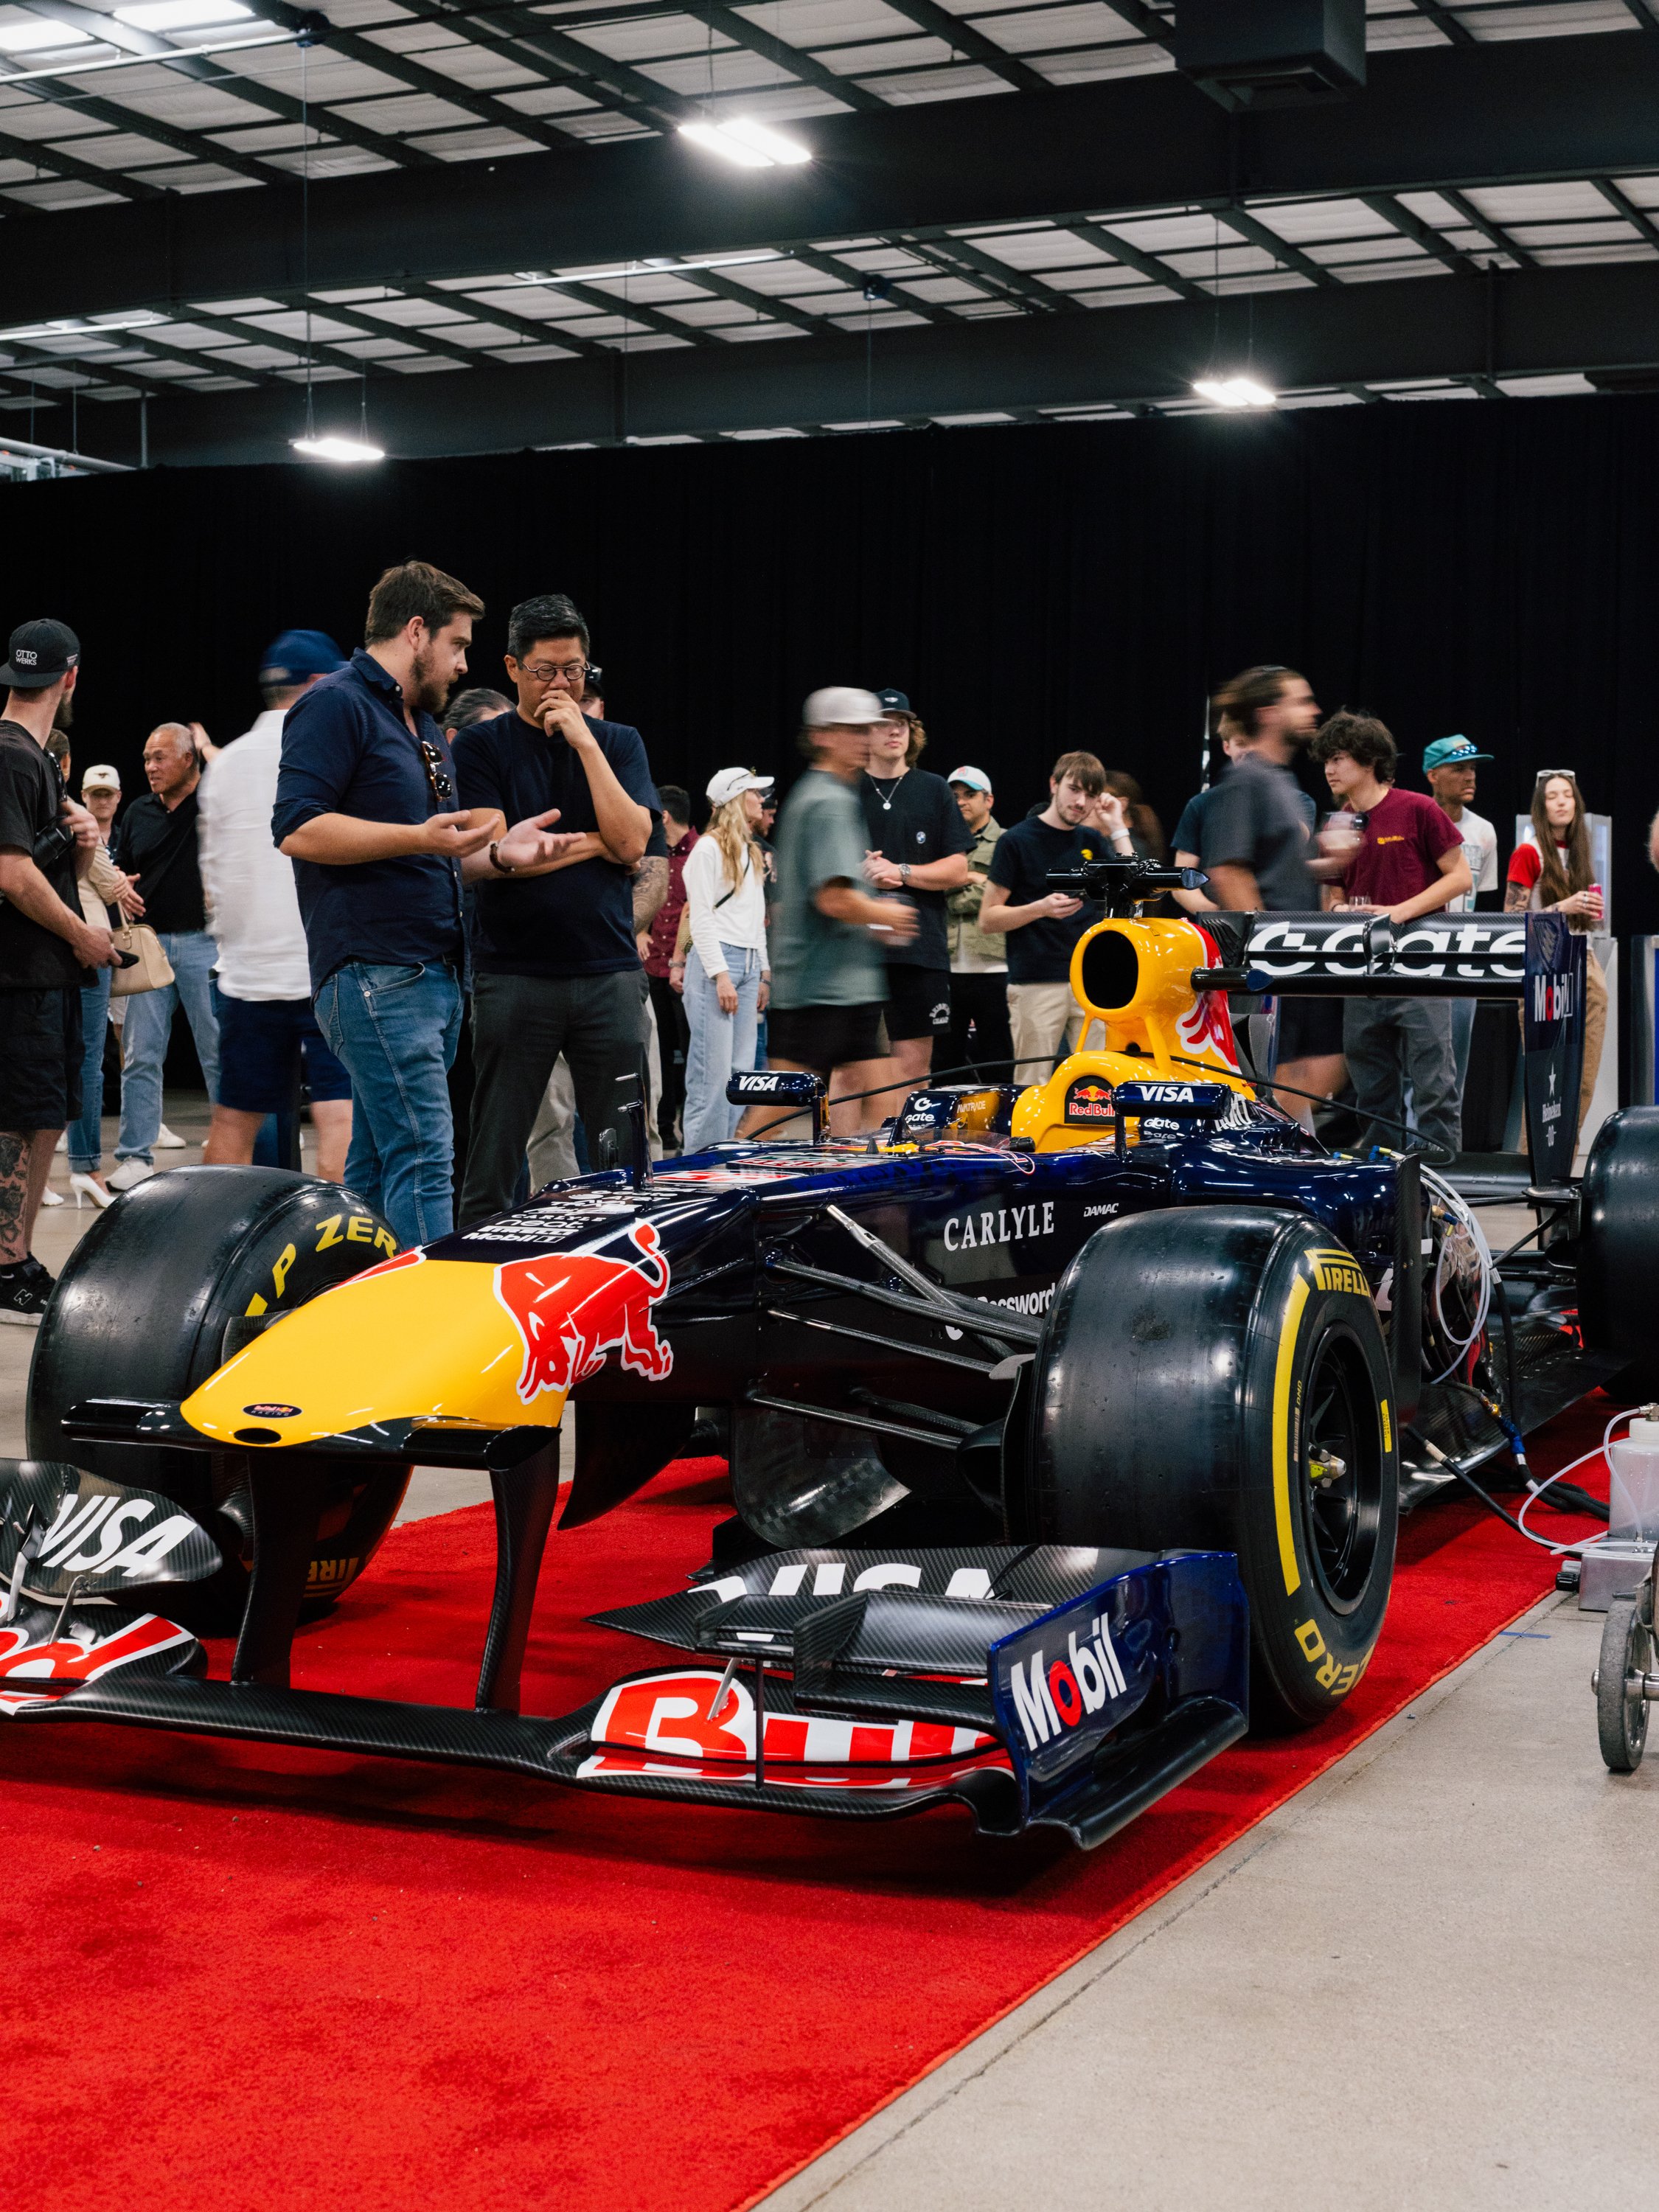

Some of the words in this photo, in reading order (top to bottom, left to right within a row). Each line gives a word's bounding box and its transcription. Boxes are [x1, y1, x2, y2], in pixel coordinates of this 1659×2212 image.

[15, 649, 38, 660] OTTO
[15, 656, 37, 666] WERKS
[739, 1076, 779, 1091] VISA
[1135, 1085, 1194, 1103] VISA
[1069, 1102, 1093, 1116] Red
[1093, 1103, 1116, 1117] Bull
[1083, 1203, 1119, 1217] DAMAC
[944, 1201, 1054, 1251] CARLYLE
[462, 1232, 538, 1242] Mobil
[272, 1242, 296, 1298] P
[316, 1214, 399, 1258] ZER
[38, 1493, 198, 1578] VISA
[1011, 1612, 1127, 1752] Mobil
